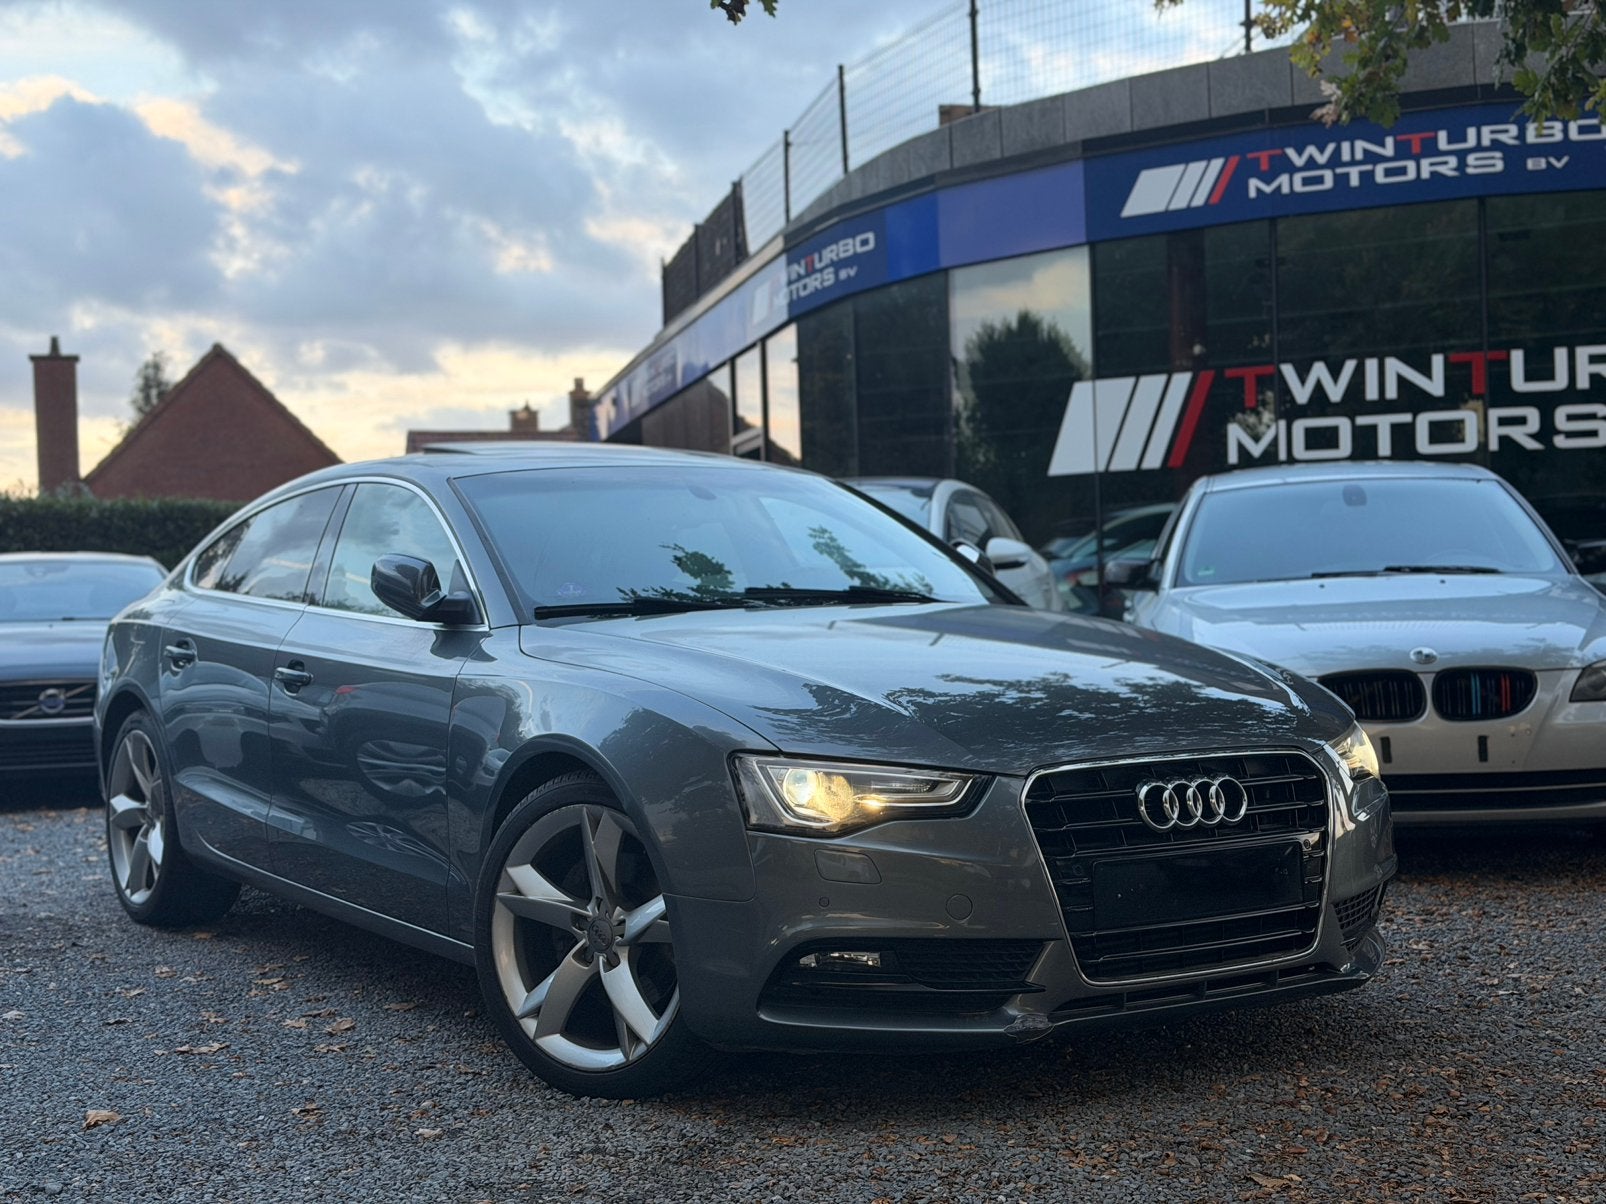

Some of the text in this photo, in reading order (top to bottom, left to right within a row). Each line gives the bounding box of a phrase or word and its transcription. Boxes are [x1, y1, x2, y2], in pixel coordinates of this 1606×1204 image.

[1247, 118, 1606, 172] TWINTURBO
[1247, 151, 1570, 199] MOTORS BV
[774, 231, 876, 284] INTURBO
[773, 266, 858, 305] OTORS BV
[1226, 403, 1606, 465] MOTORS
